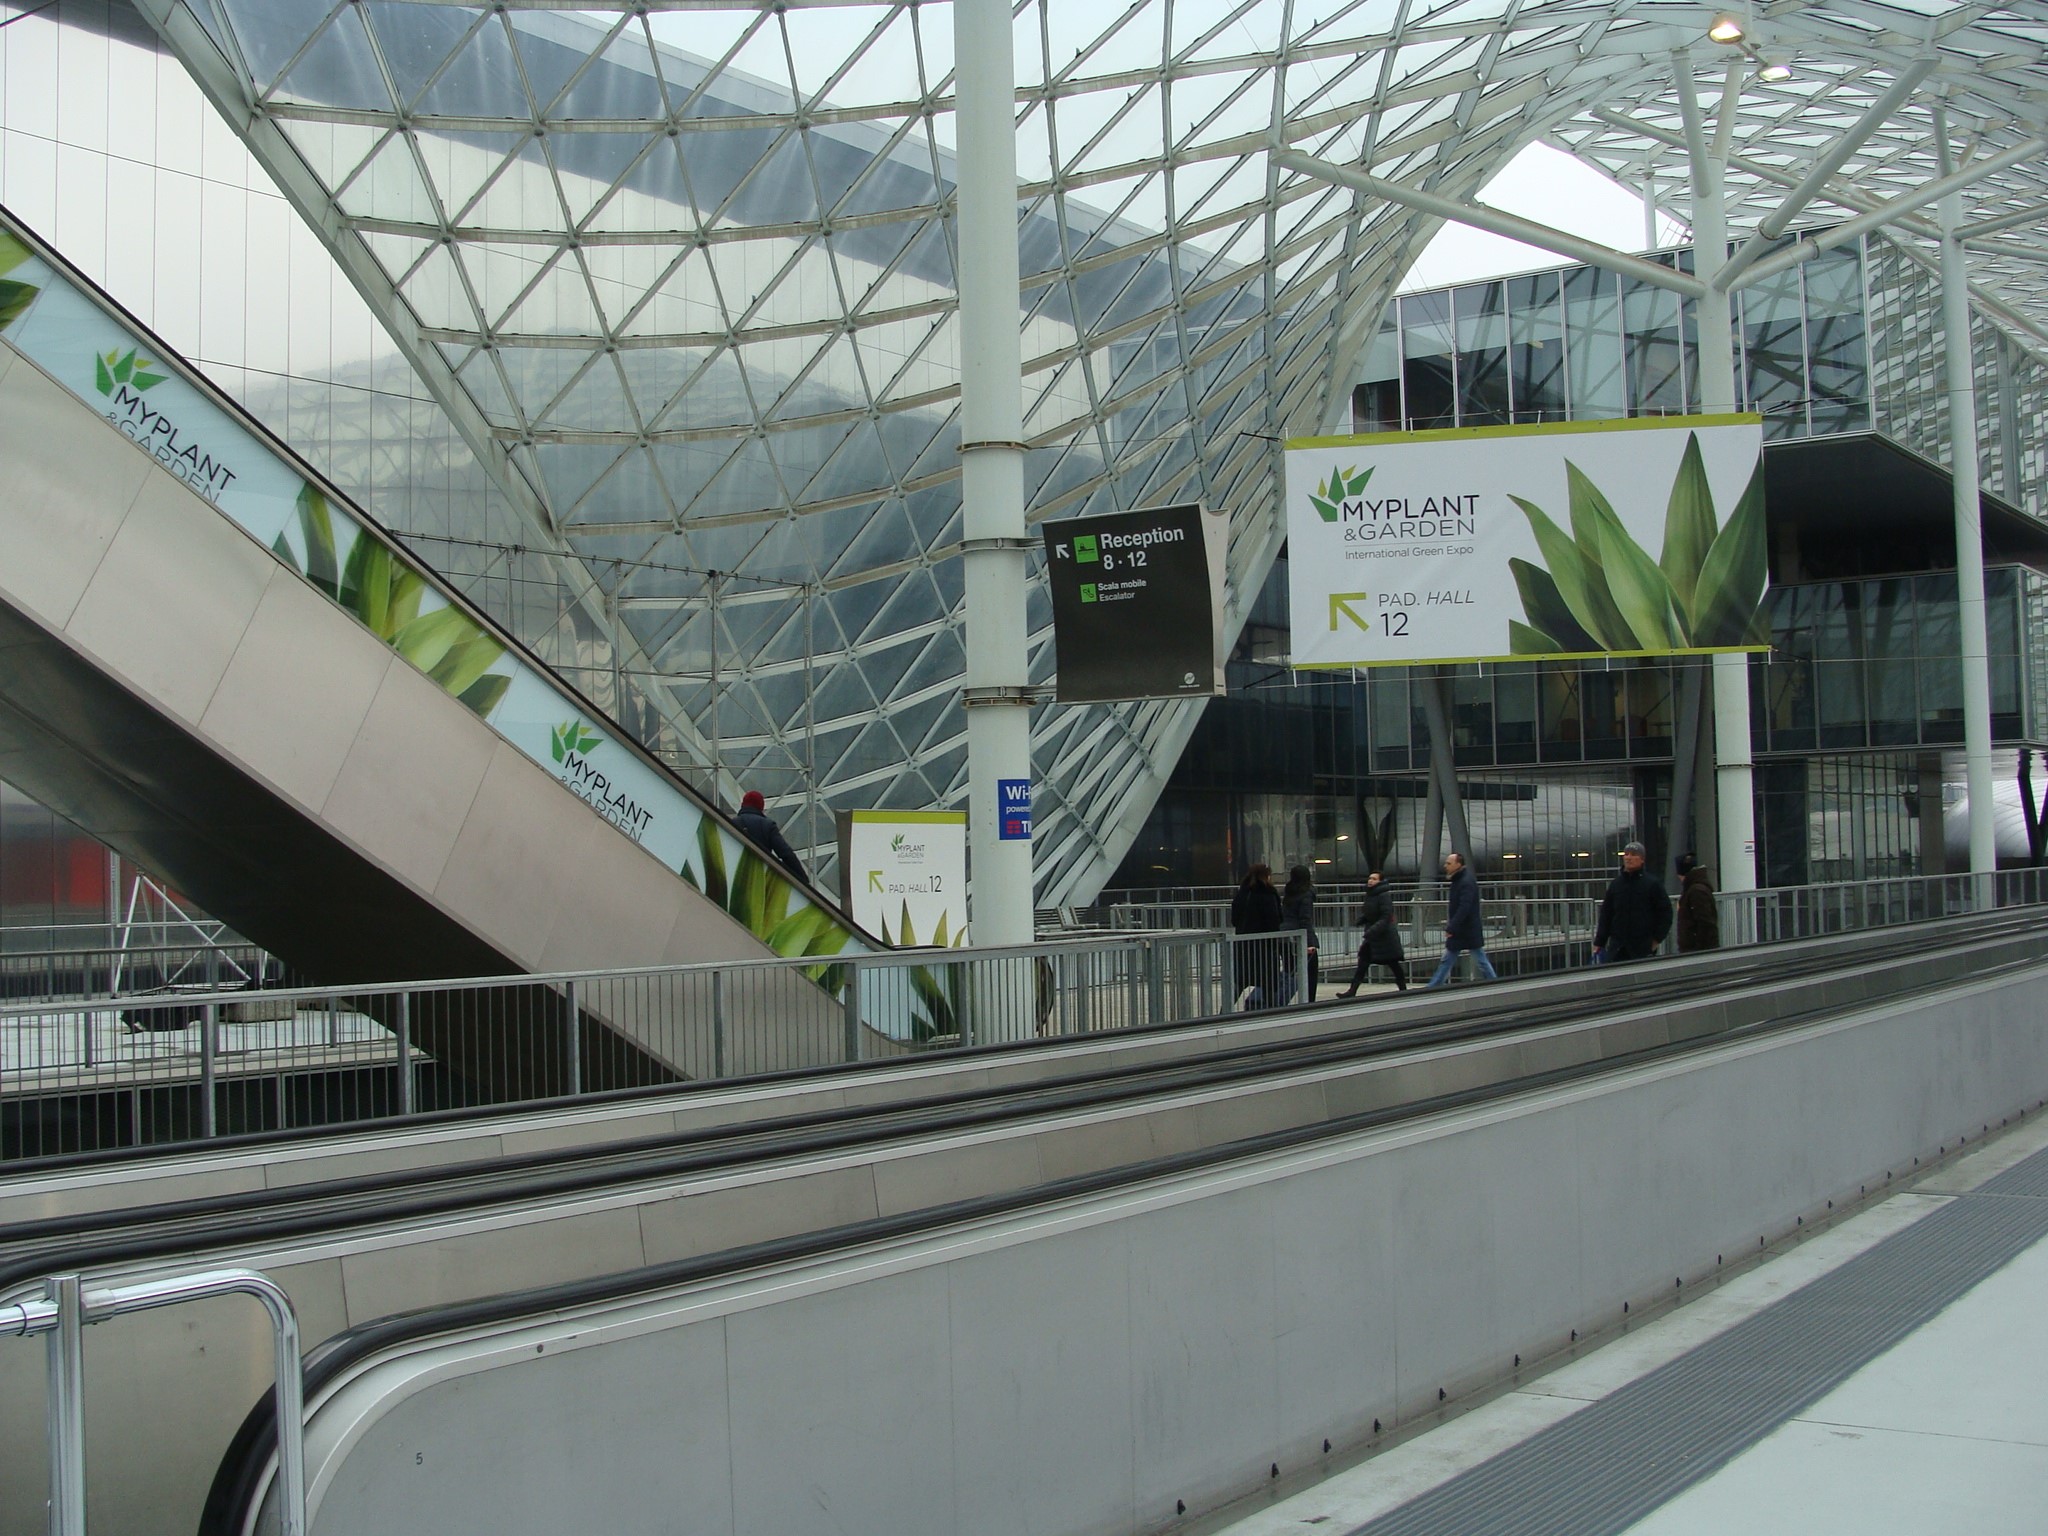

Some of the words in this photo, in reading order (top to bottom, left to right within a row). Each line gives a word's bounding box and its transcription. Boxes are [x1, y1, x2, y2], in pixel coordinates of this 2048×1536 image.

[114, 385, 236, 490] MYPLANT
[1343, 494, 1480, 522] MYPLANT
[1100, 527, 1185, 550] Reception
[1344, 518, 1475, 541] &GARDEN
[1103, 554, 1114, 570] 8
[1127, 550, 1148, 568] 12
[1345, 547, 1410, 560] International
[1412, 546, 1444, 557] Green
[1447, 545, 1475, 556] Expo
[1098, 581, 1120, 591] Scala
[1120, 579, 1147, 589] mobile
[1099, 591, 1136, 602] Escalator
[1378, 592, 1421, 607] PAD.
[1426, 590, 1475, 605] HALL
[1380, 611, 1409, 637] 12
[565, 751, 653, 831] MYPLANT
[897, 844, 925, 852] MYPLANT
[889, 884, 907, 894] PAD.
[908, 883, 929, 893] HALL
[929, 875, 942, 893] 12
